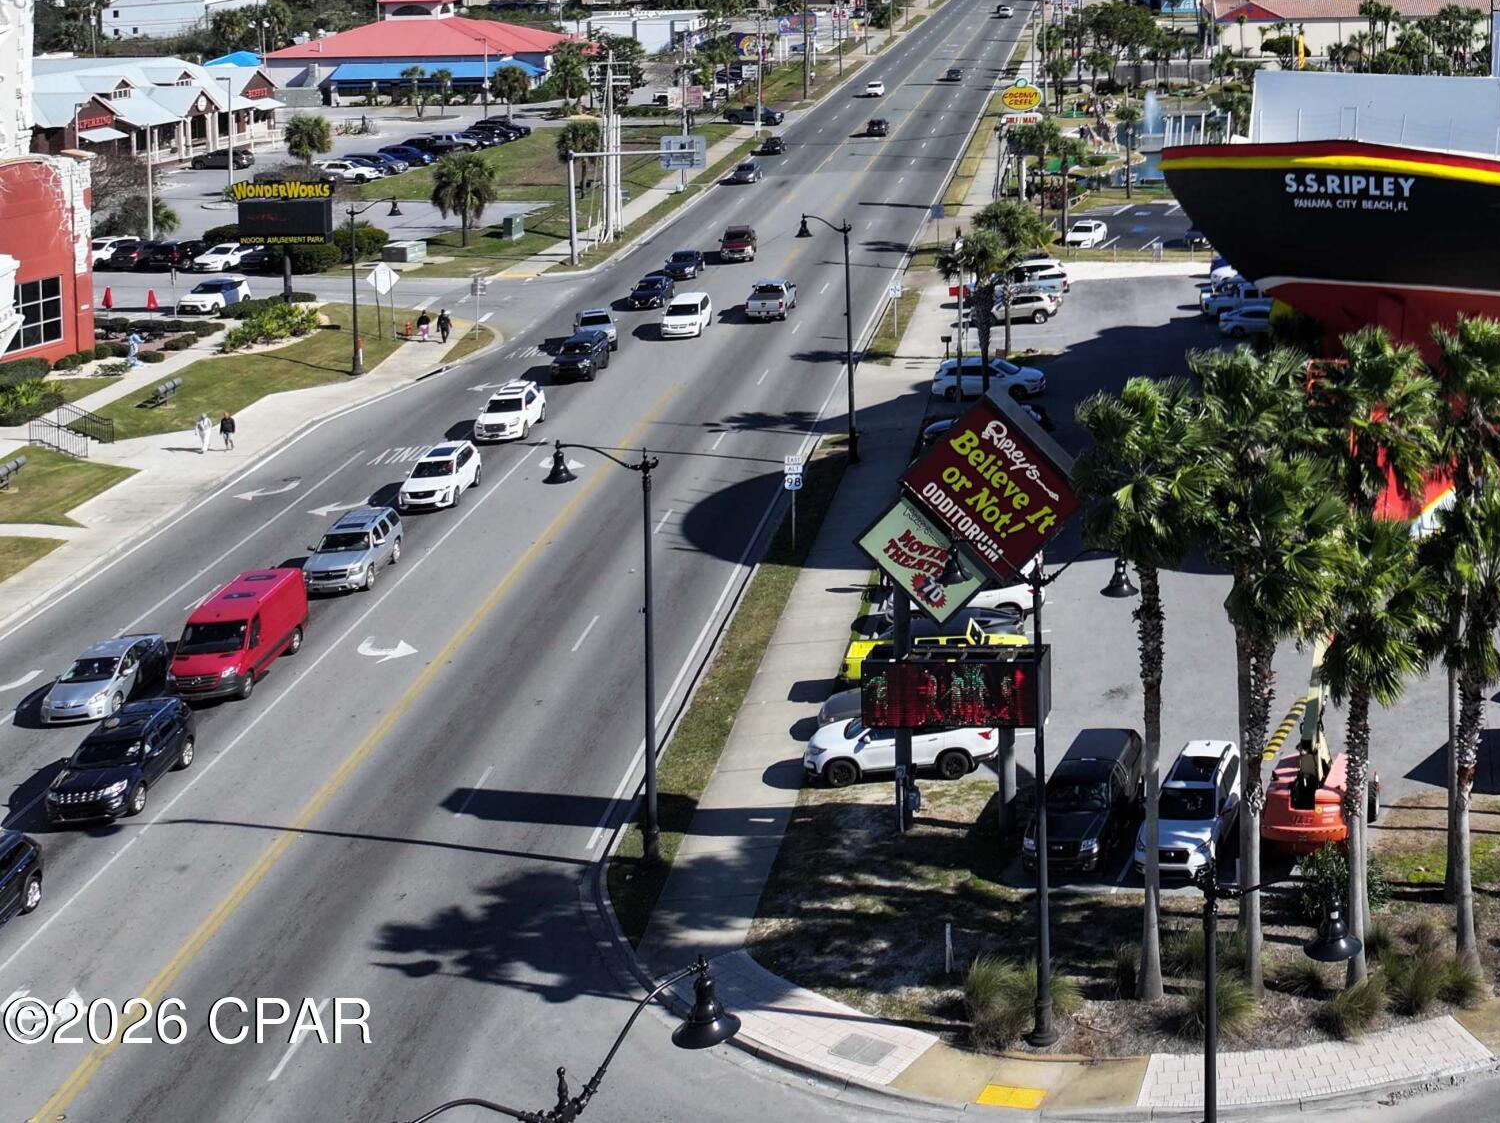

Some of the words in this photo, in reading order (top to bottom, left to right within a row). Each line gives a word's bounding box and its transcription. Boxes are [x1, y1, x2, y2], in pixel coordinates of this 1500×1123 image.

[1003, 91, 1038, 99] COCONUT
[1294, 198, 1333, 209] PANAMA
[1336, 199, 1357, 209] CITY
[240, 237, 265, 245] INDOOR
[307, 236, 325, 244] PARK
[786, 477, 801, 487] 98
[950, 430, 1030, 510] Believe
[1026, 506, 1057, 535] It
[942, 467, 973, 493] or
[965, 487, 1026, 539] Not!
[922, 482, 1005, 564] ODDITORIUM
[923, 576, 944, 603] 7D
